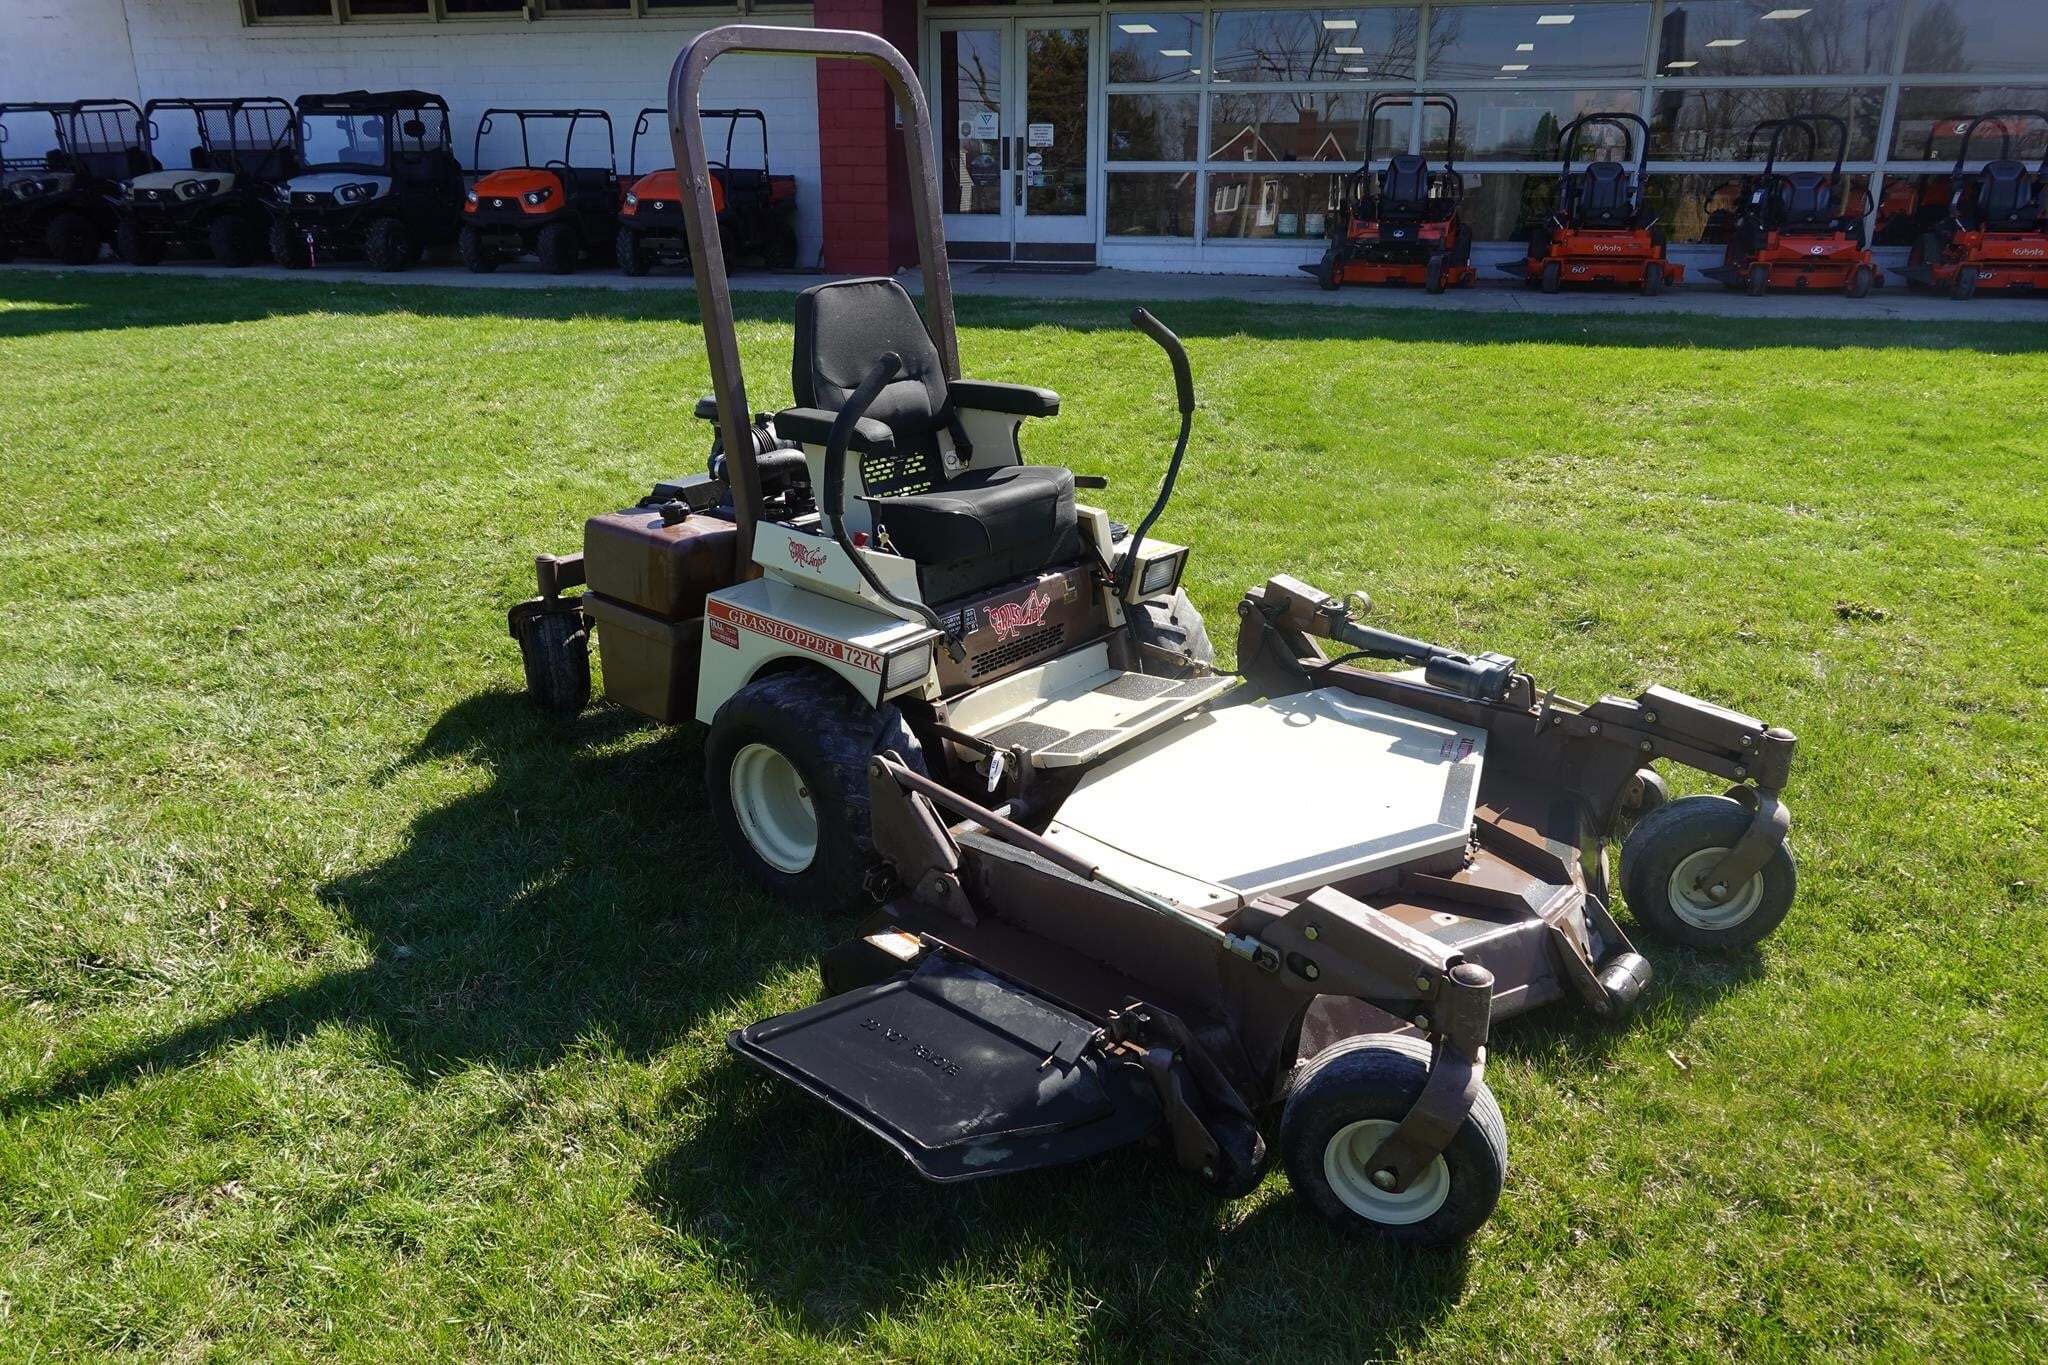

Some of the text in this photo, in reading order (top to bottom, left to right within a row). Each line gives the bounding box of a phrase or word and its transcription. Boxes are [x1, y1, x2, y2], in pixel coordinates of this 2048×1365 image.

[1593, 244, 1622, 252] Kubota
[2012, 247, 2045, 256] Kubota
[728, 609, 835, 656] GRASSHOPPER
[844, 646, 882, 673] 727K
